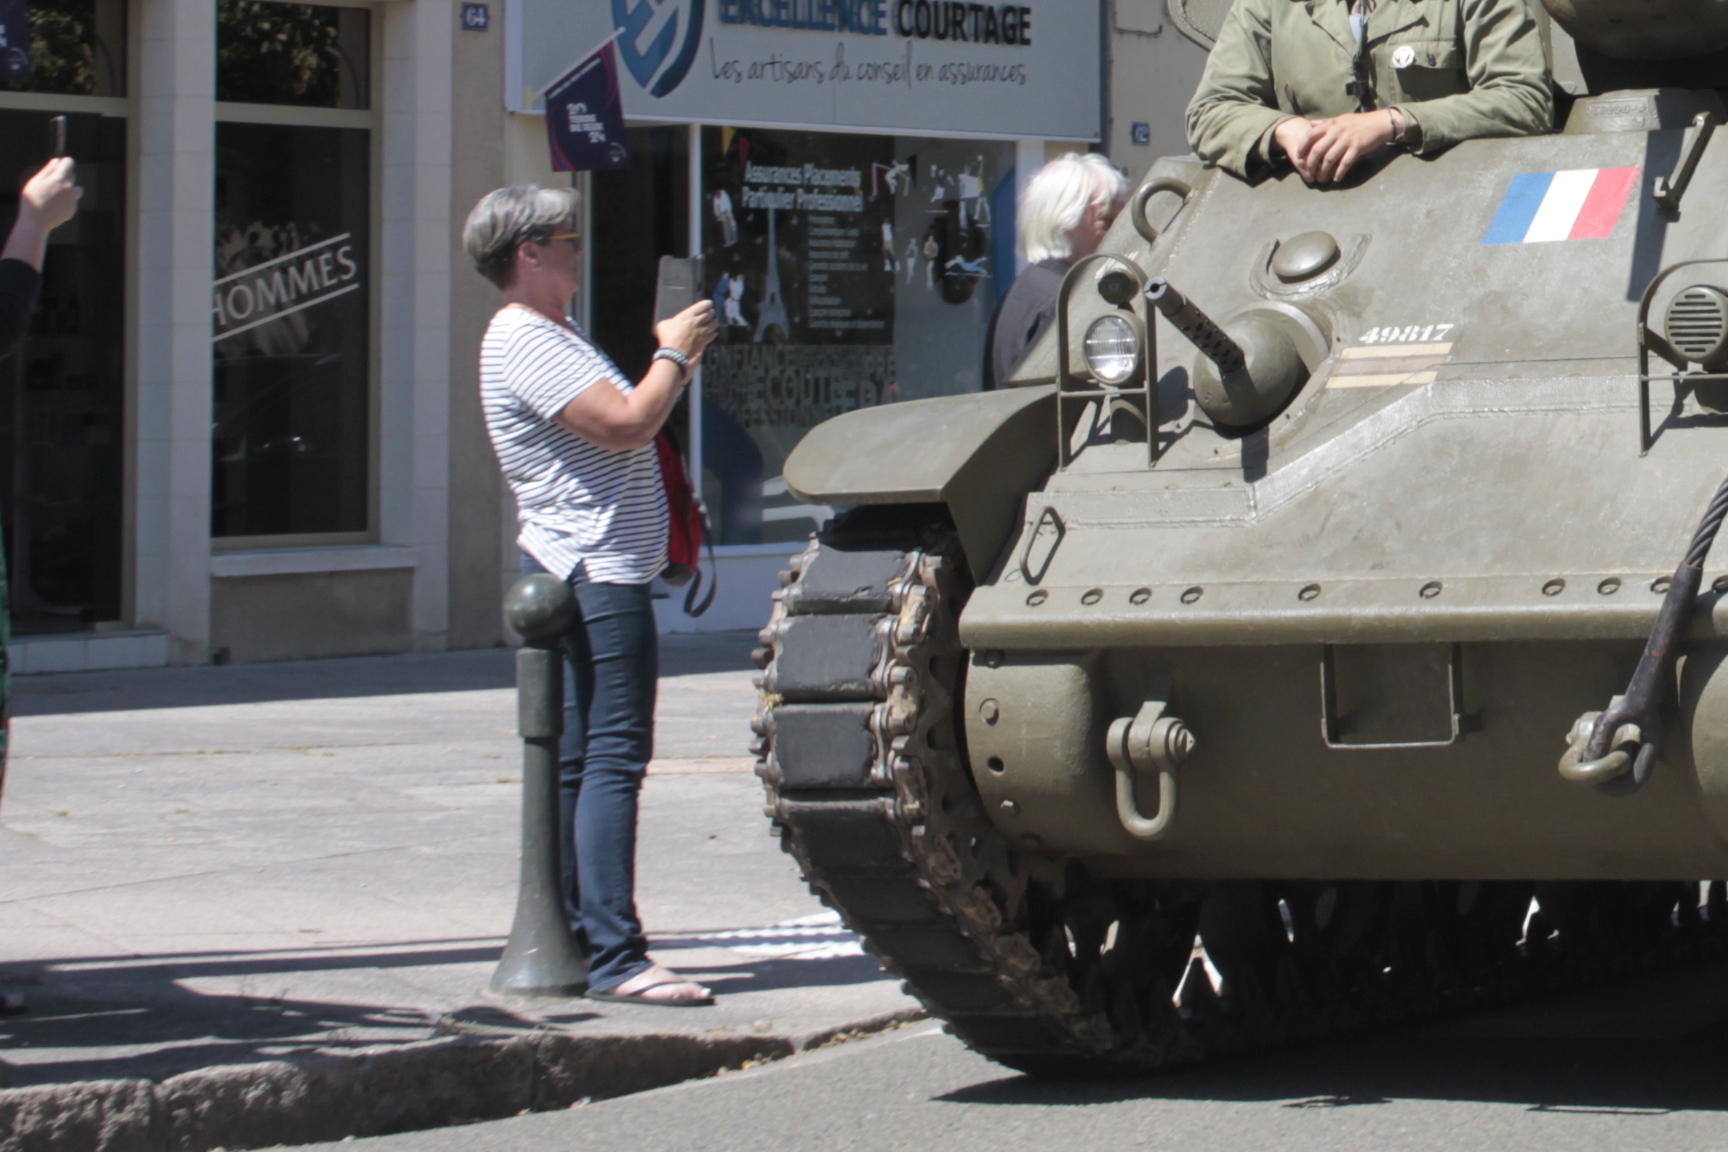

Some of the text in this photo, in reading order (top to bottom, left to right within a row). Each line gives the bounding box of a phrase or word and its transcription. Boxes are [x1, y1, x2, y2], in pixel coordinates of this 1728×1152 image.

[466, 6, 486, 26] 64
[709, 36, 1027, 89] Les artisans du conseil en assurances
[744, 160, 862, 186] Assurances Placements
[742, 186, 864, 212] Particulier Professionnel
[1358, 323, 1455, 344] 49817
